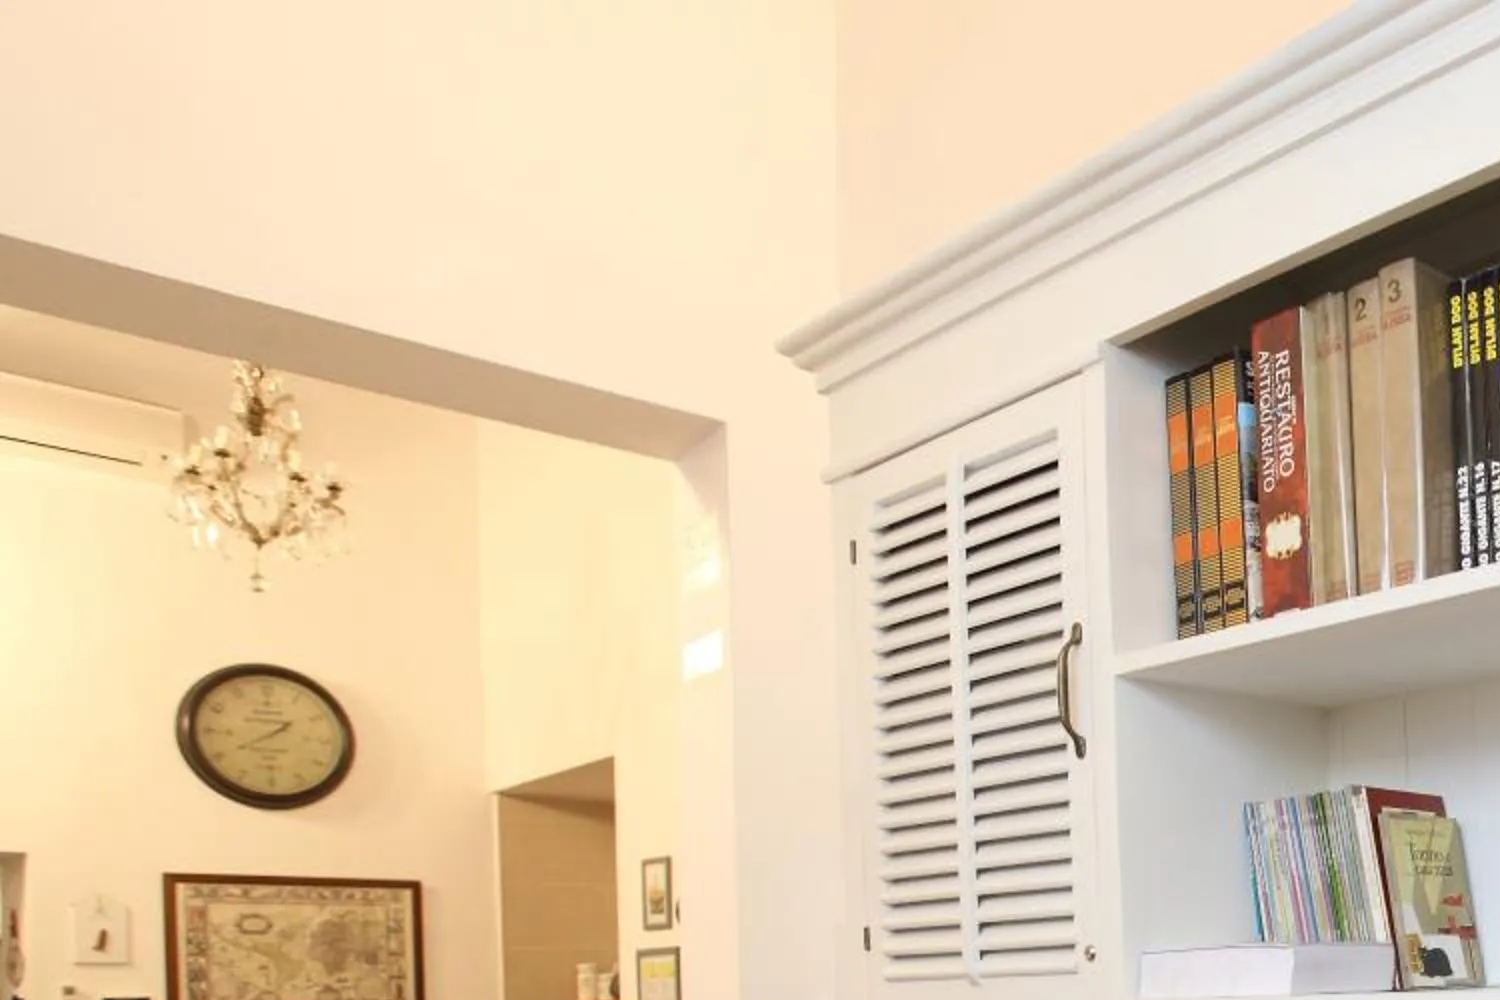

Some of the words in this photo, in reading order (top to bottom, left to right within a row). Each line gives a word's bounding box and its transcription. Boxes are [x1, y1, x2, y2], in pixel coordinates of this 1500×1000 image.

[1353, 298, 1368, 323] 2
[1387, 279, 1402, 304] 3
[1451, 296, 1461, 324] DOG
[1468, 292, 1479, 320] DOG
[1484, 287, 1494, 316] DOG
[1452, 327, 1463, 368] DYLAN
[1469, 323, 1481, 364] DYLAN
[1485, 318, 1497, 360] DYLAN
[1257, 349, 1276, 494] ANTIQUARIATO
[1274, 348, 1296, 478] RESTAURO
[1460, 500, 1472, 555] GIGANTE
[1475, 496, 1488, 549] GIGANTE
